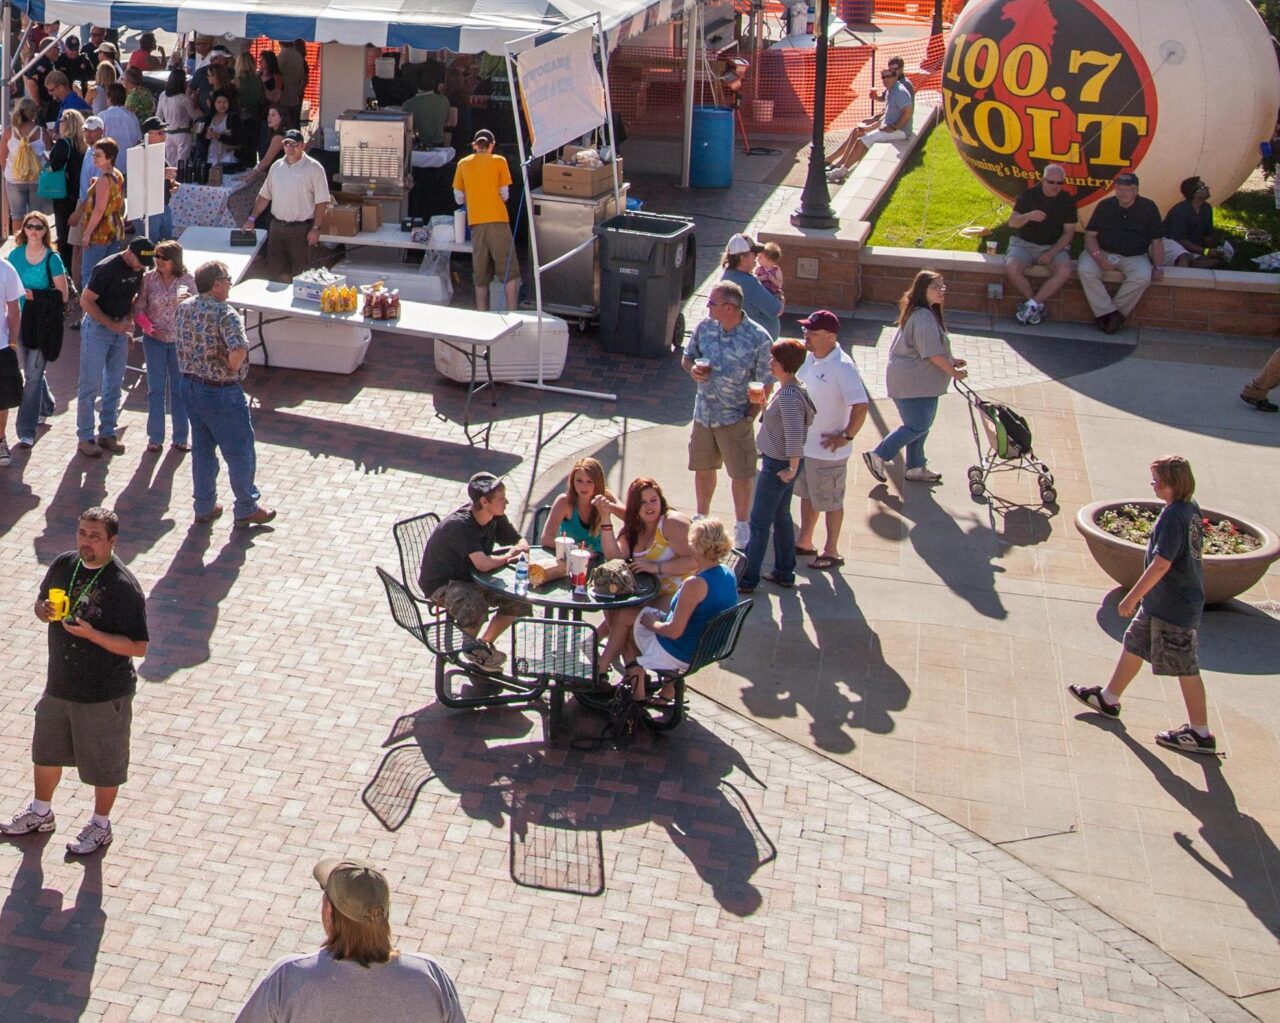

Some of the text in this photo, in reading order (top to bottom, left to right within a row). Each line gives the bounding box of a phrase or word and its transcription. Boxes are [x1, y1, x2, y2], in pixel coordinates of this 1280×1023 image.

[946, 32, 1123, 104] 100.7
[942, 86, 1148, 167] KOLT
[1011, 165, 1041, 181] Best
